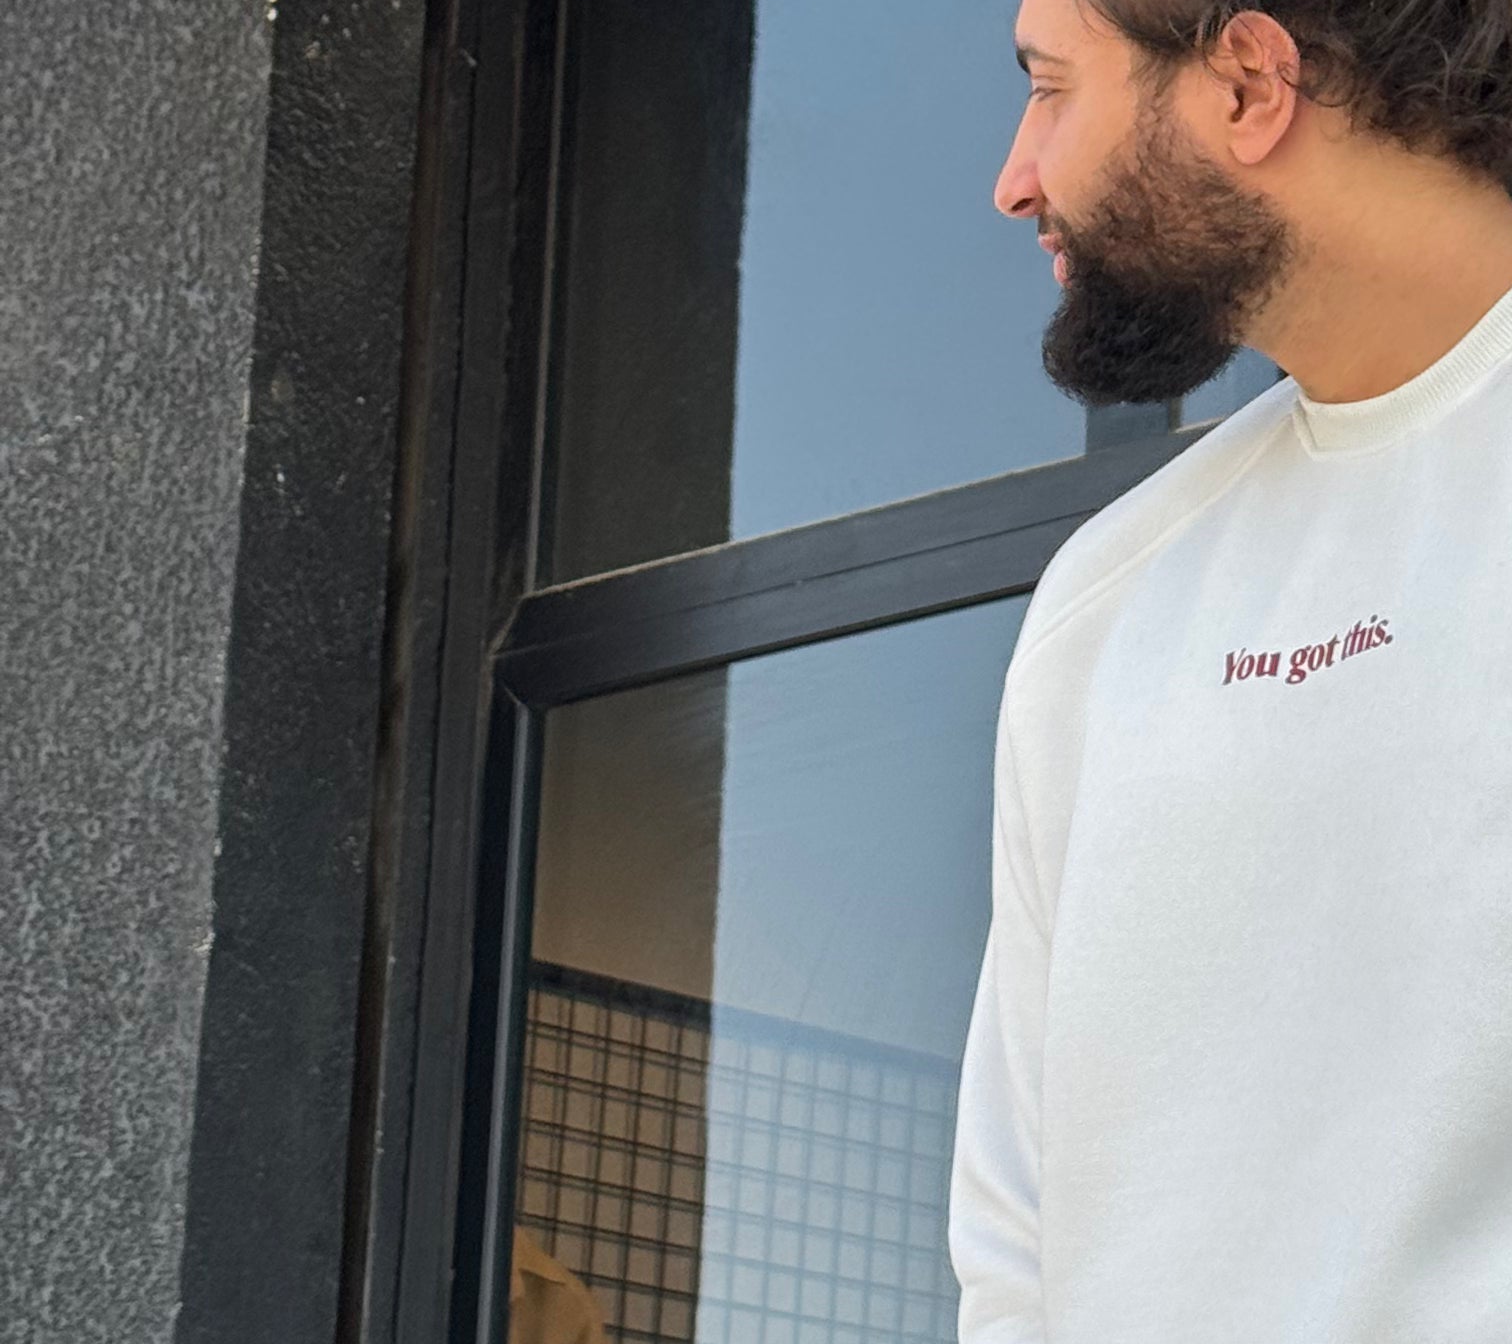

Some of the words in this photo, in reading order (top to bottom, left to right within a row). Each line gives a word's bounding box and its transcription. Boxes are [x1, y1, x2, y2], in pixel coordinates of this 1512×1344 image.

[1222, 647, 1281, 685] You
[1285, 635, 1340, 685] got
[1341, 614, 1394, 661] this.
